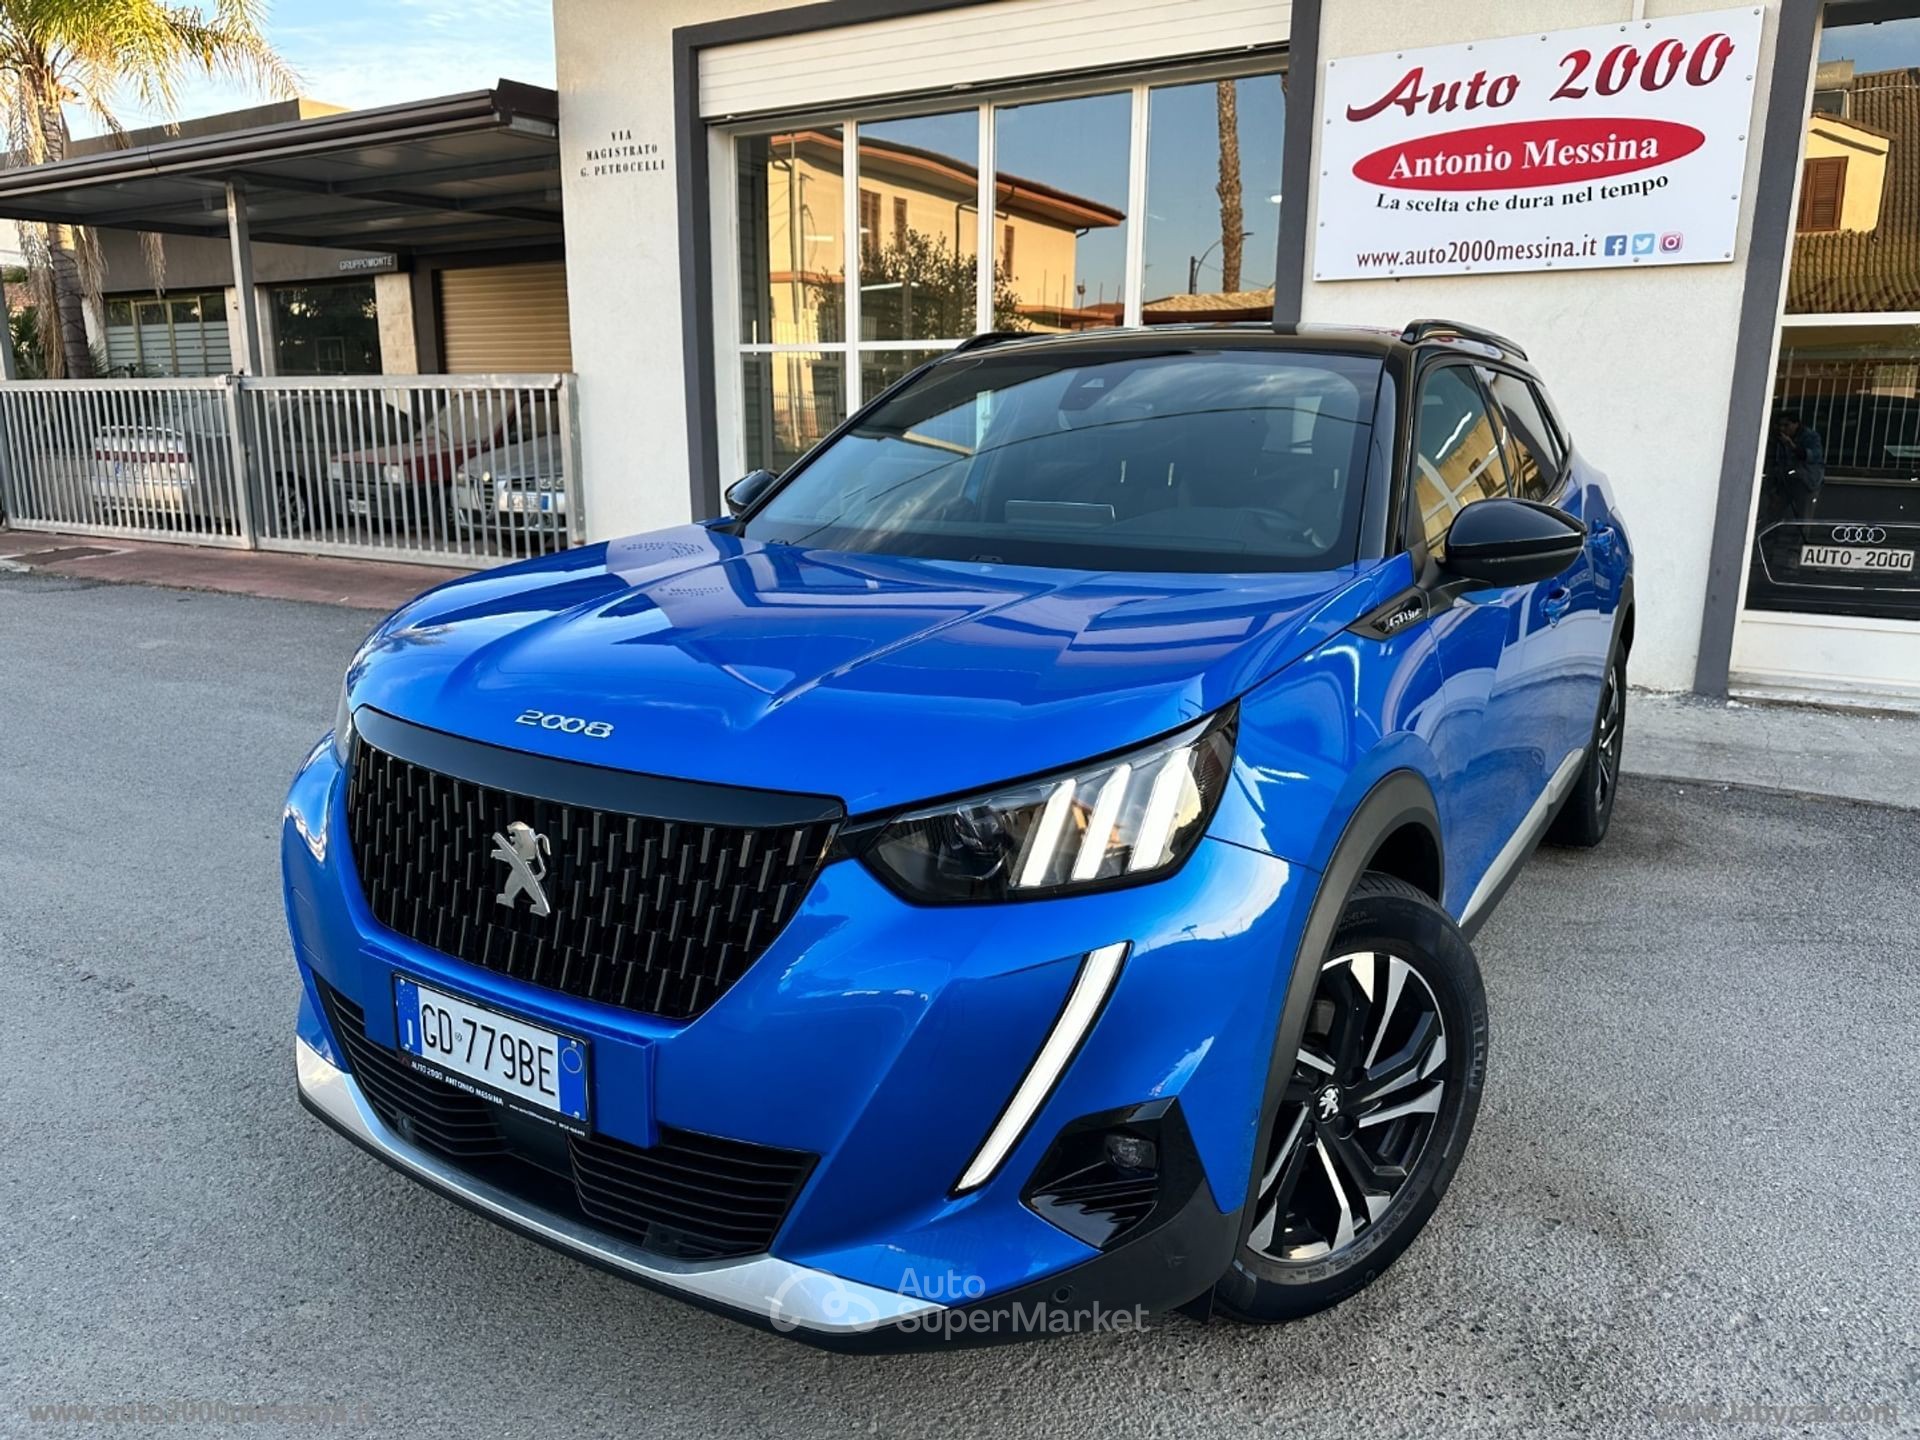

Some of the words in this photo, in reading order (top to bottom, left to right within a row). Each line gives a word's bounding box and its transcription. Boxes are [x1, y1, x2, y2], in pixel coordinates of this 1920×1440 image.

[1346, 66, 1521, 122] Auto
[1549, 33, 1735, 101] 2000
[611, 129, 632, 141] VIA
[580, 167, 590, 177] G.
[594, 159, 665, 176] PETROCELLI
[586, 144, 658, 161] MAGISTRATO
[1388, 144, 1512, 180] Antonio
[1521, 133, 1659, 169] Messina
[1376, 193, 1400, 211] La
[1405, 197, 1459, 212] scelta
[1466, 196, 1499, 212] che
[1505, 194, 1554, 210] dura
[1562, 186, 1593, 206] nel
[1600, 175, 1669, 197] tempo
[1357, 233, 1597, 268] www.auto2000messina.it
[515, 709, 615, 738] 2008
[445, 1075, 475, 1095] ANTONIO
[475, 1088, 504, 1107] MESSINA
